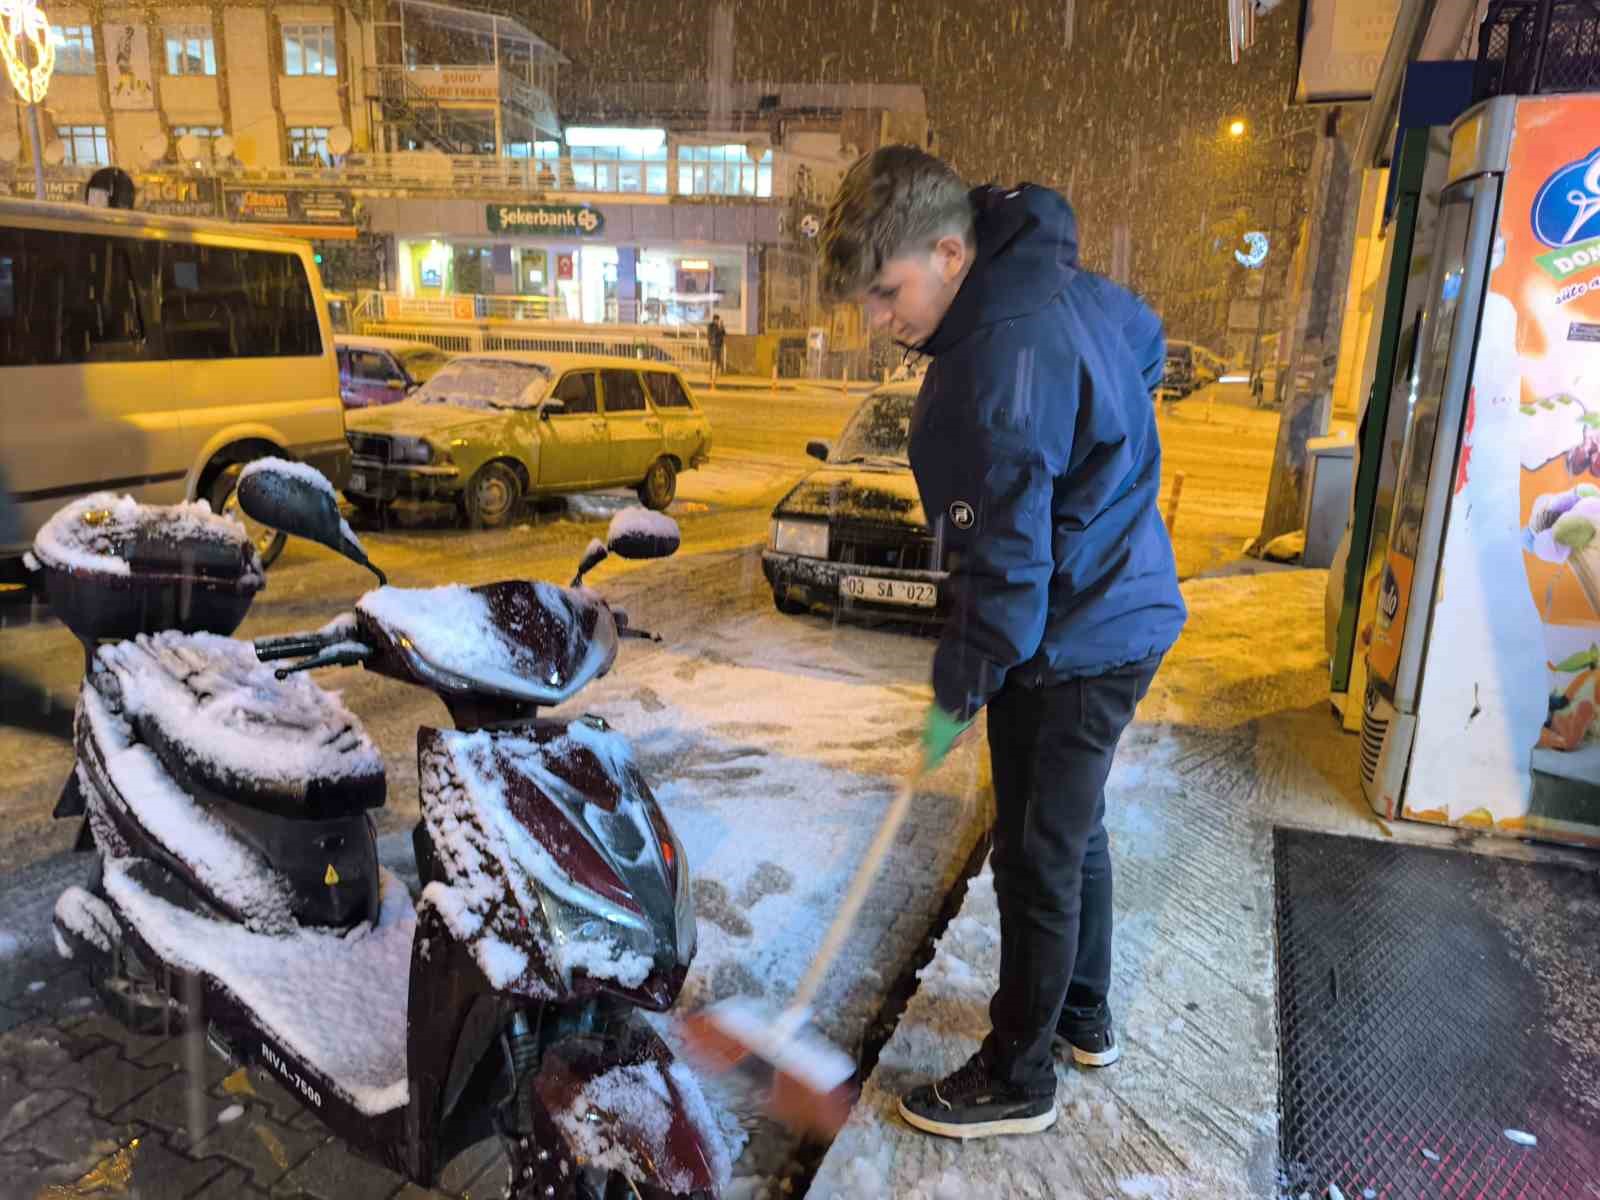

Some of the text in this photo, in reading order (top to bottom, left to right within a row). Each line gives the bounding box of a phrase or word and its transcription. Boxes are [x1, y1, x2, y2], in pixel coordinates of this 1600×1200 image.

[499, 207, 575, 229] Şekerbank
[847, 578, 865, 594] 03
[877, 581, 894, 597] SA
